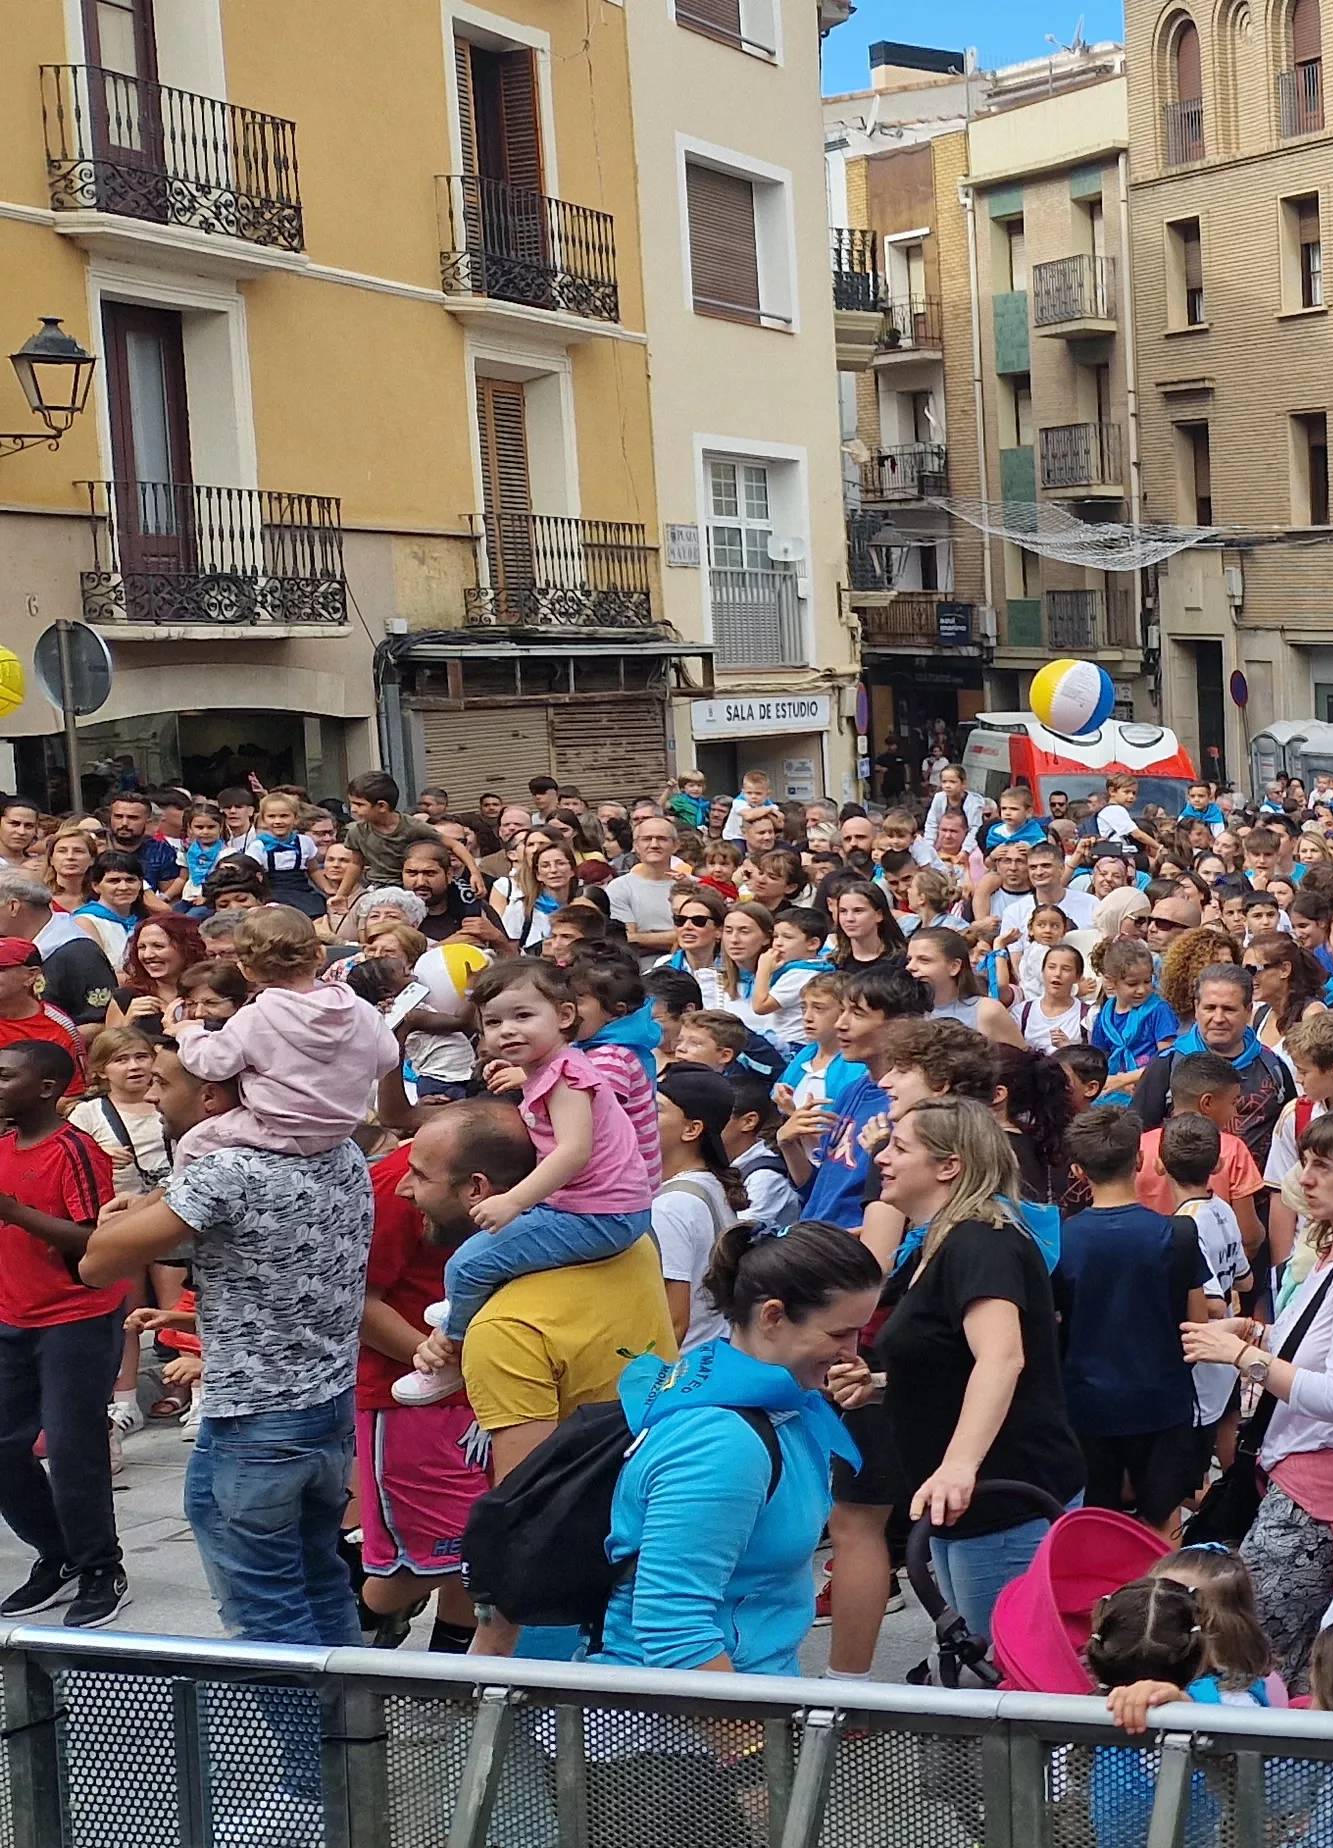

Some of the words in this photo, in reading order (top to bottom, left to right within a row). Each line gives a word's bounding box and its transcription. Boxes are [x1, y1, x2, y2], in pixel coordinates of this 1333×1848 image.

[27, 594, 39, 617] 6
[726, 704, 755, 722] SALA
[759, 704, 772, 720] DE
[775, 701, 818, 719] ESTUDIO
[432, 1537, 462, 1556] HE
